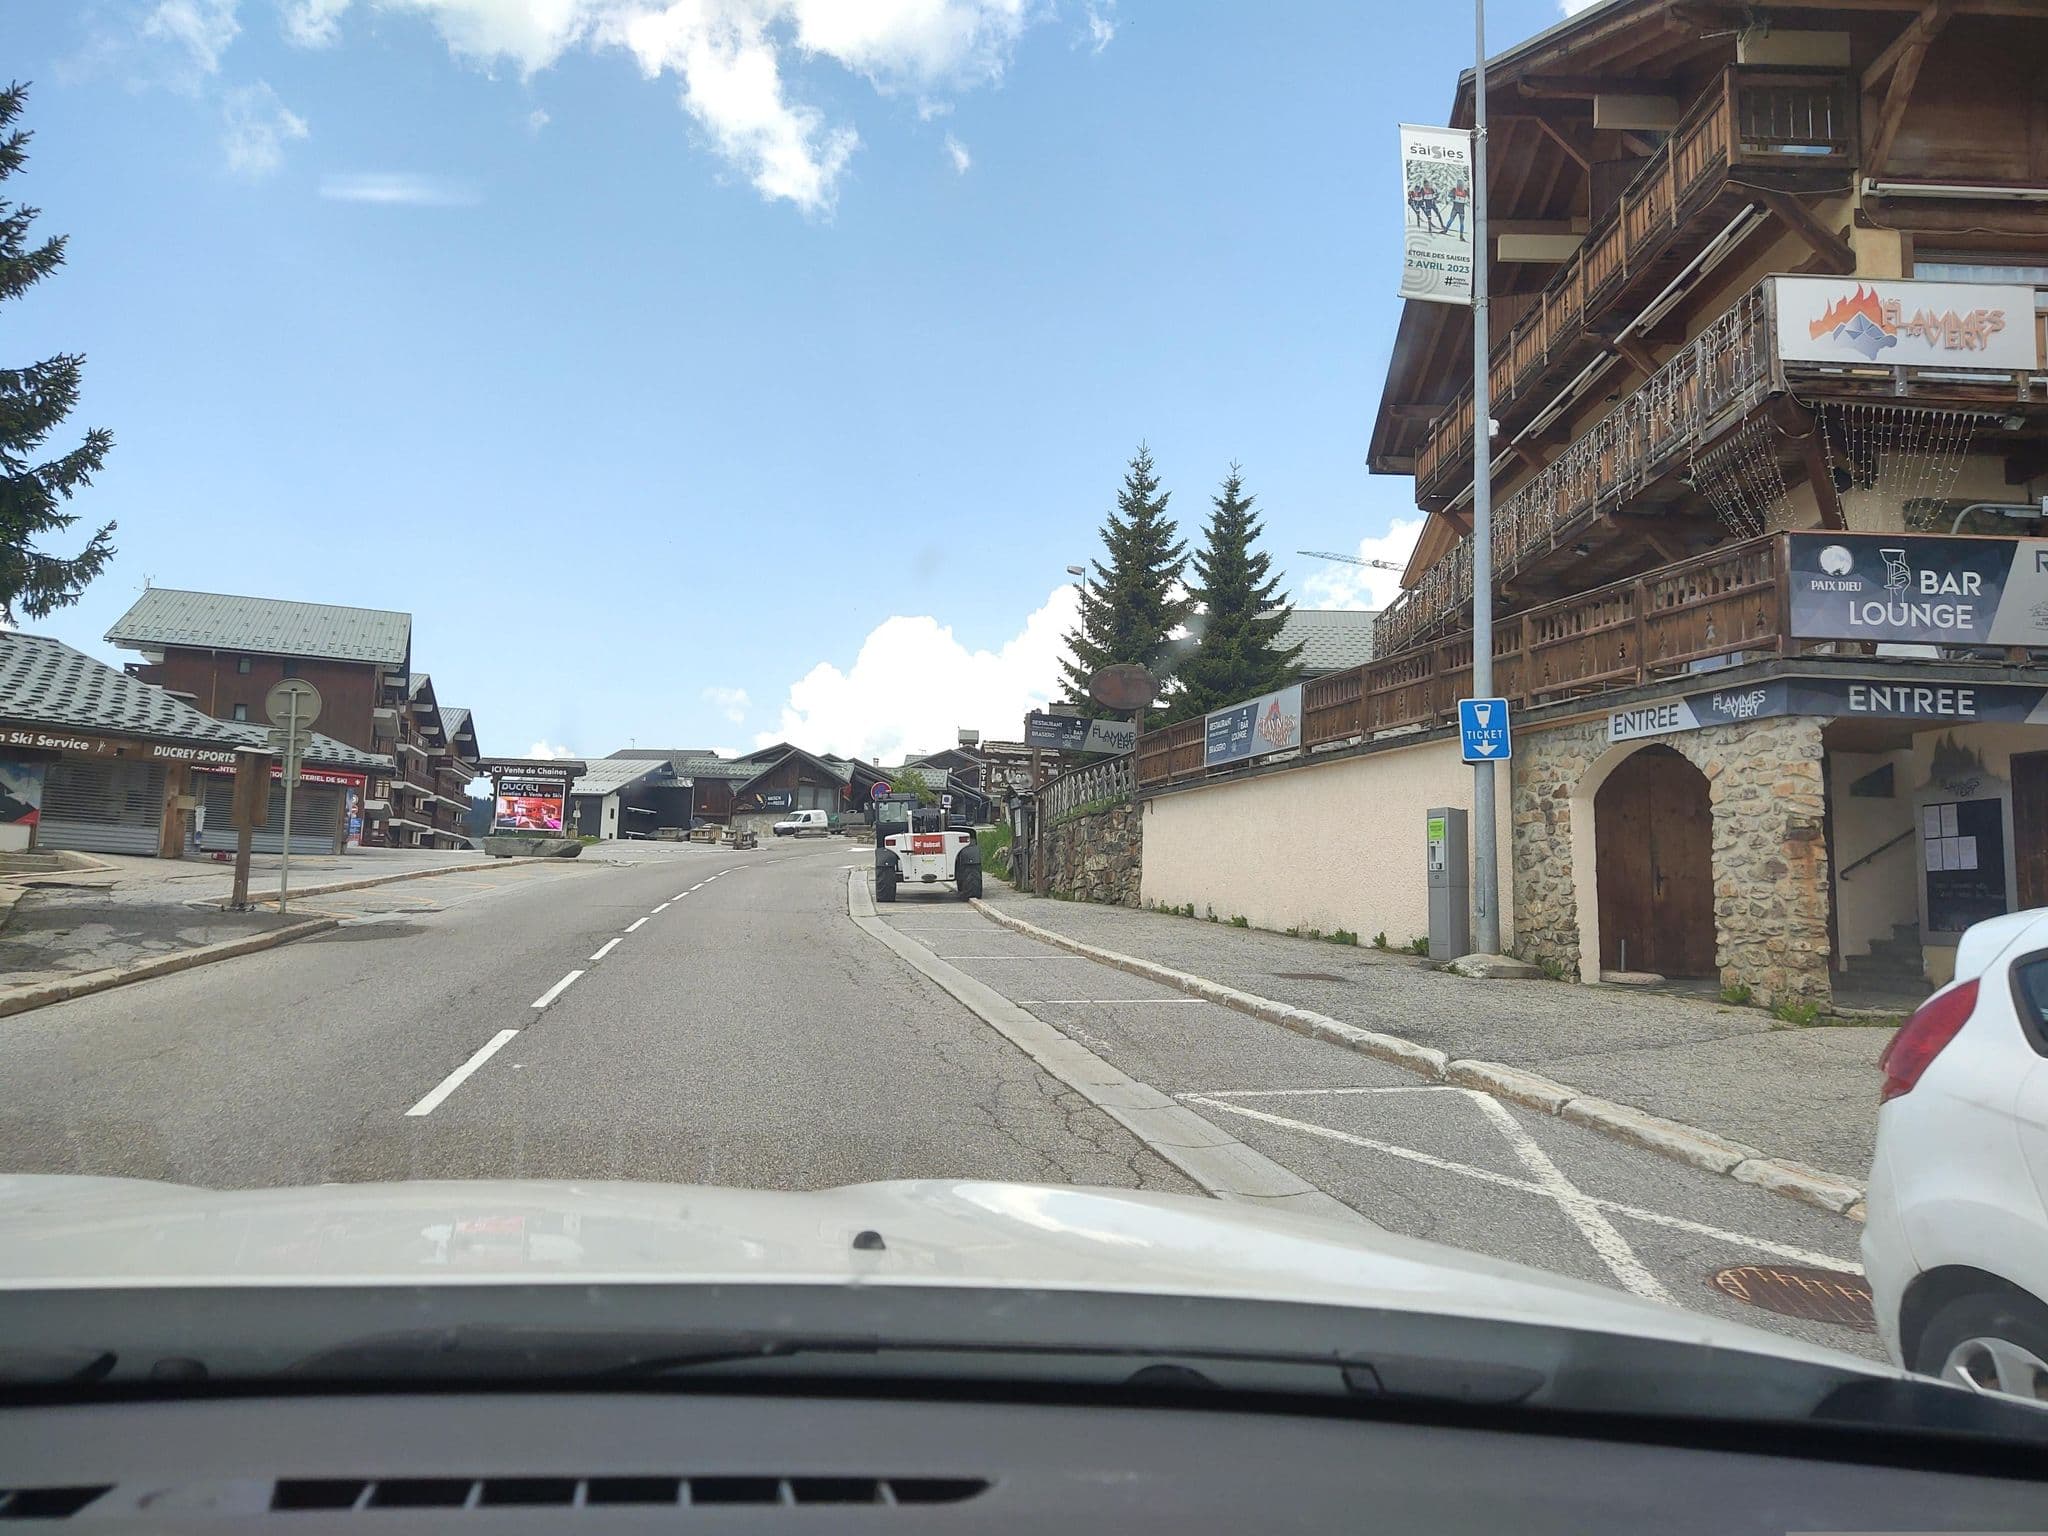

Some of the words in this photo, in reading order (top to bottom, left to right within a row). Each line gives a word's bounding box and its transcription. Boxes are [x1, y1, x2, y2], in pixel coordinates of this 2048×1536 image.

[1446, 254, 1470, 262] SAISIES
[1408, 259, 1413, 267] 2
[1416, 260, 1444, 271] AVRIL
[1447, 264, 1470, 273] 2023
[1882, 303, 2006, 332] FLAMMES
[1923, 325, 1996, 351] VERY
[1811, 580, 1836, 592] PAIX
[1838, 581, 1862, 592] DIEU
[1920, 570, 1982, 597] BAR
[1849, 601, 1974, 630] LOUNGE
[1712, 690, 1766, 711] FLAMMES
[1848, 685, 1977, 716] ENTREE
[1730, 702, 1759, 718] VERY
[1031, 719, 1063, 728] RESTAURANT
[1209, 717, 1232, 731] RESTAURANT
[1240, 720, 1249, 730] BAR
[1614, 704, 1679, 735] ENTREE
[9, 732, 32, 745] Ski
[36, 735, 89, 751] Service
[1092, 728, 1136, 741] FLAMME
[1231, 730, 1247, 741] LOUNGE
[1466, 729, 1503, 740] TICKET
[153, 746, 195, 759] DUCREY
[197, 750, 236, 763] SPORTS
[503, 766, 524, 774] Vente
